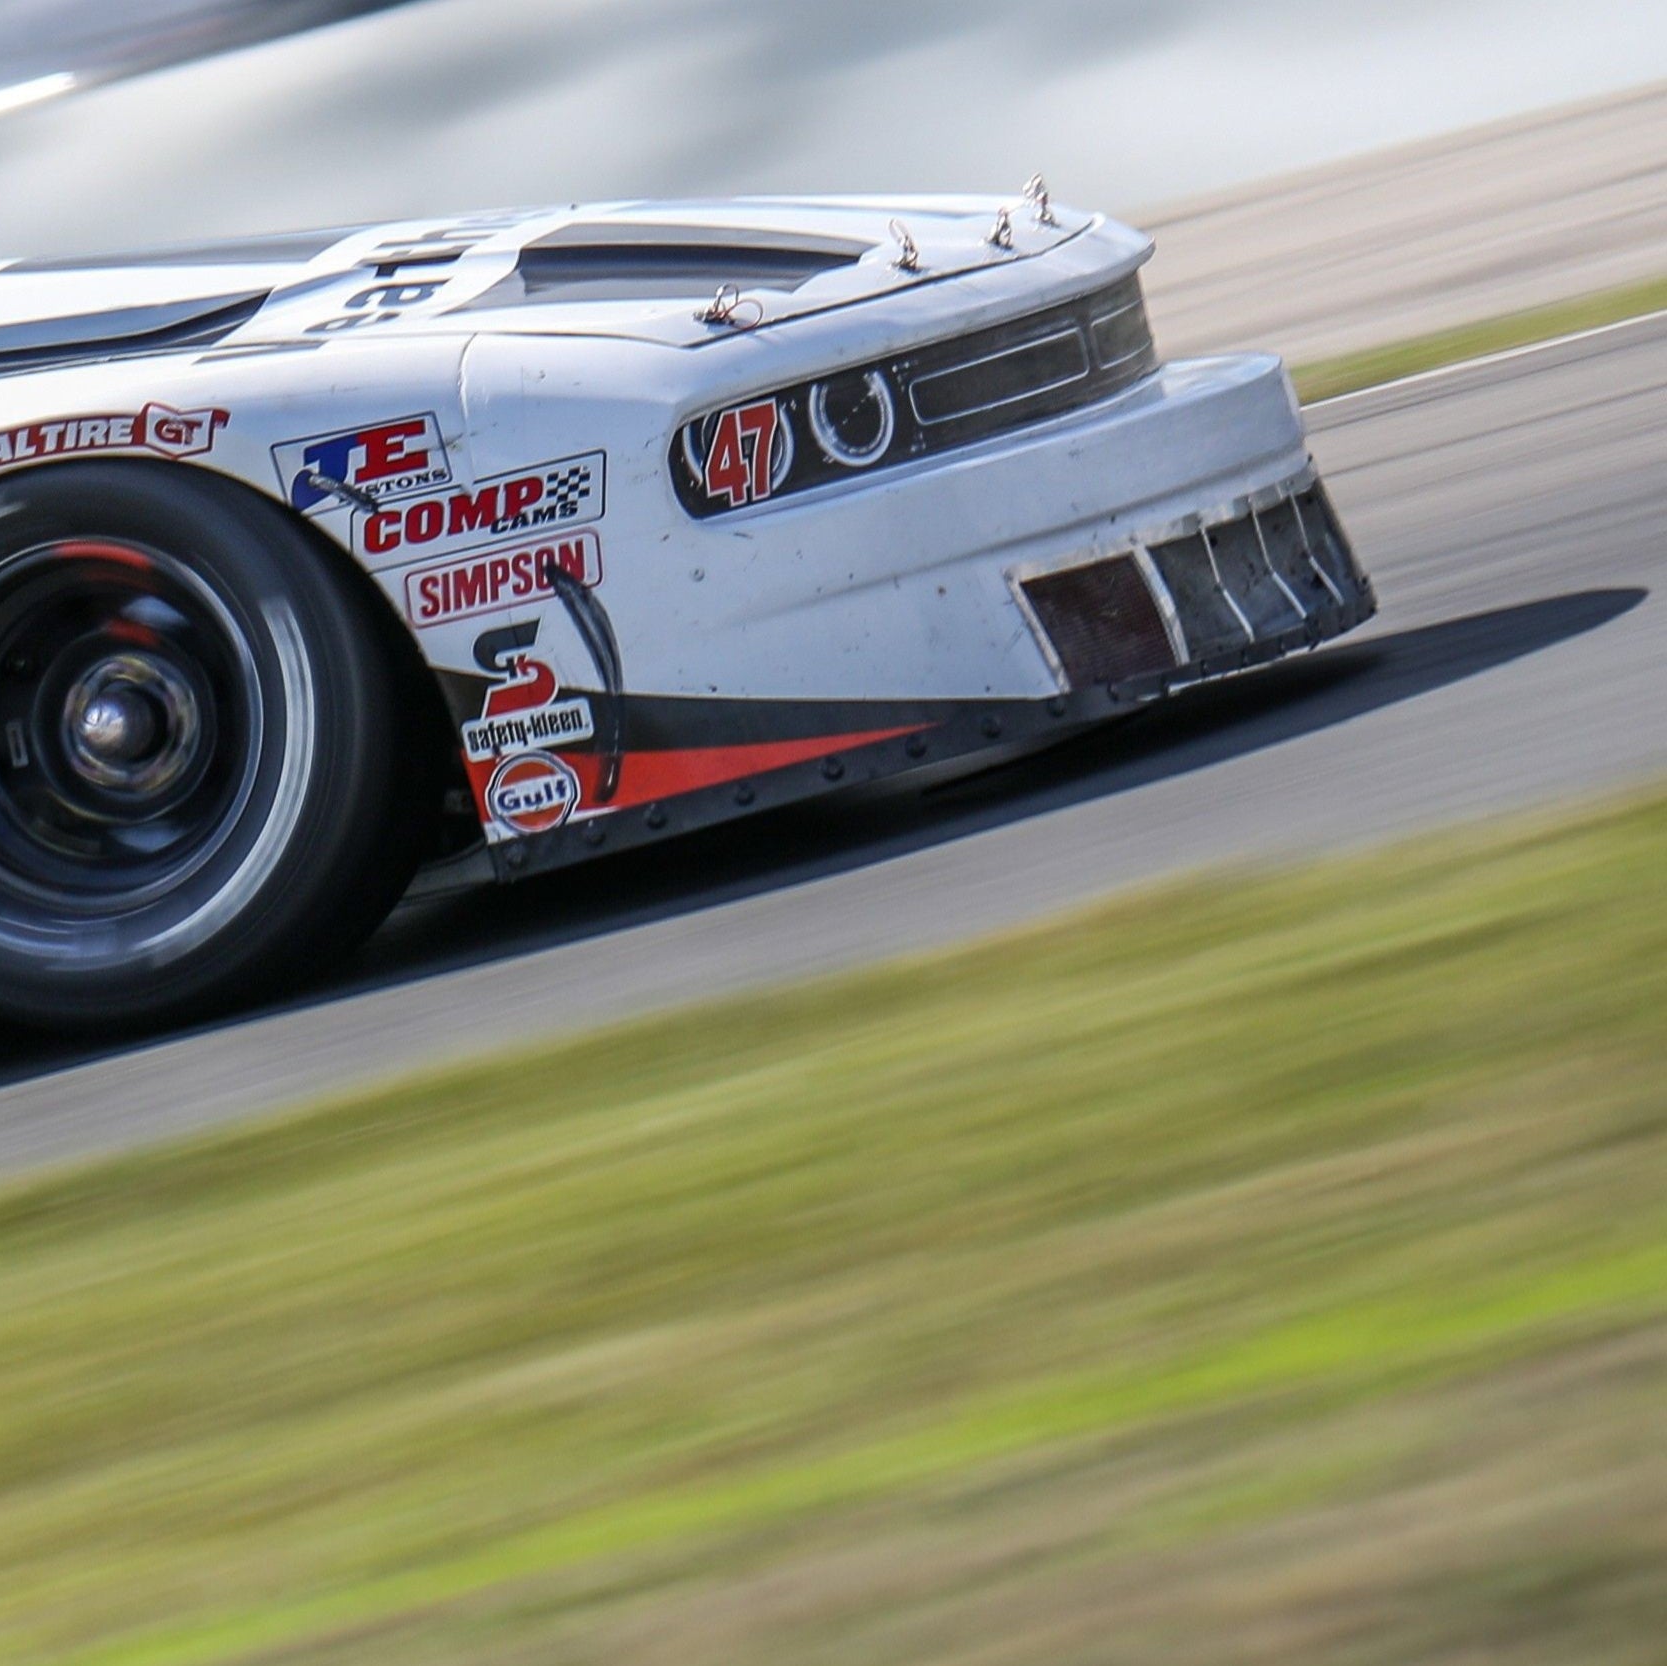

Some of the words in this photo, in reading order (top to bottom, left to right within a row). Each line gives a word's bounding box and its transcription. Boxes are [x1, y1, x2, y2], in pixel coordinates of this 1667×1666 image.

[38, 416, 137, 451] TIRE
[705, 397, 778, 507] 47
[291, 419, 429, 512] JE
[339, 468, 448, 504] STONS
[363, 475, 544, 555] COMP
[490, 500, 578, 534] CAMS
[419, 538, 585, 619] SIMPSON
[497, 779, 568, 811] Gulf
